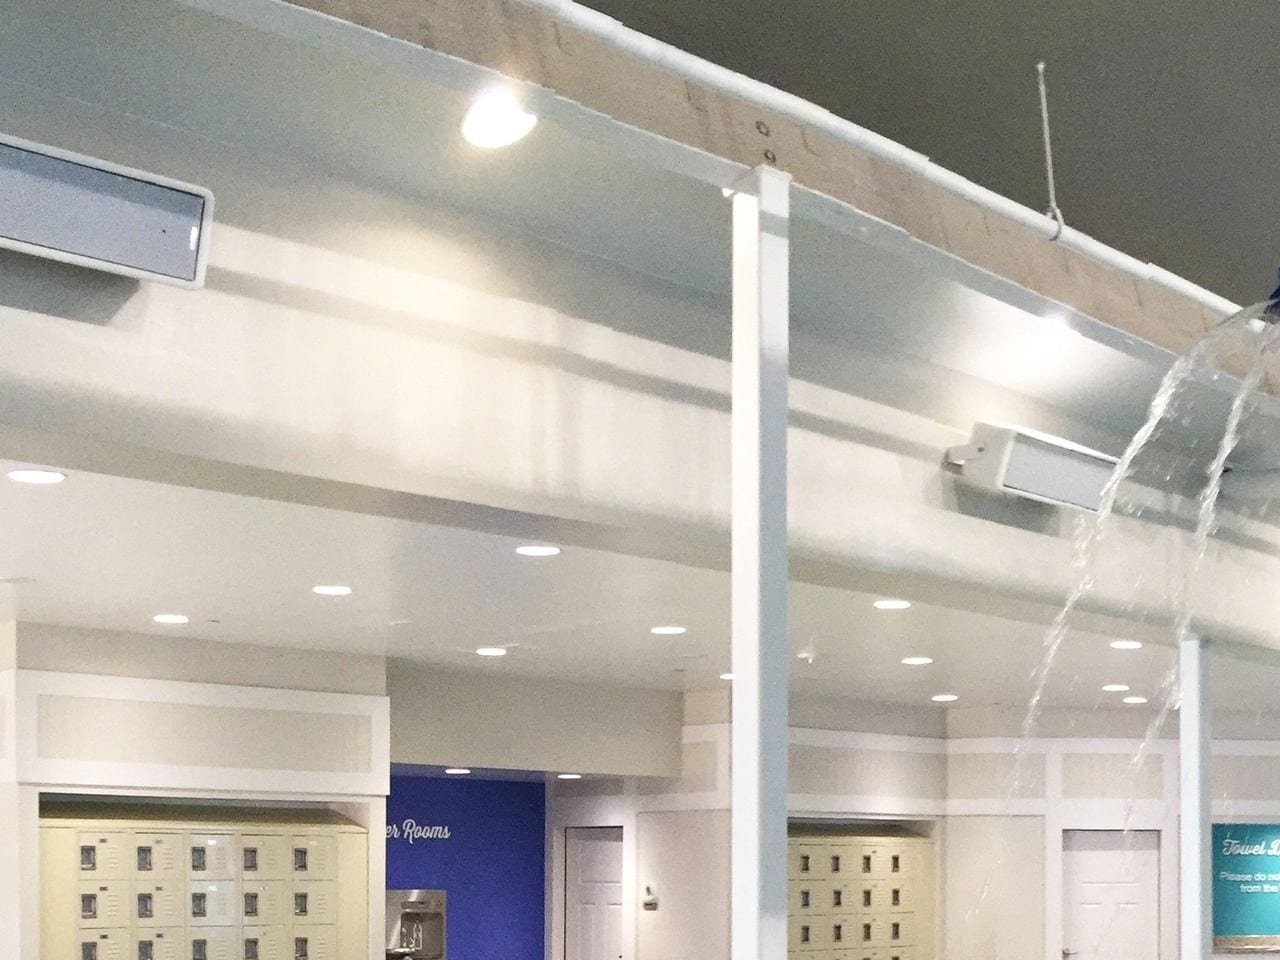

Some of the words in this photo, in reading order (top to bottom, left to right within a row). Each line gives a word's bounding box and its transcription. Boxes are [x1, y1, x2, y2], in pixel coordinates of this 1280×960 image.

[402, 818, 452, 845] Rooms
[1222, 839, 1267, 856] Towel
[1220, 871, 1253, 881] Please
[1254, 873, 1267, 881] do
[1240, 884, 1261, 893] from
[1262, 884, 1279, 893] the
